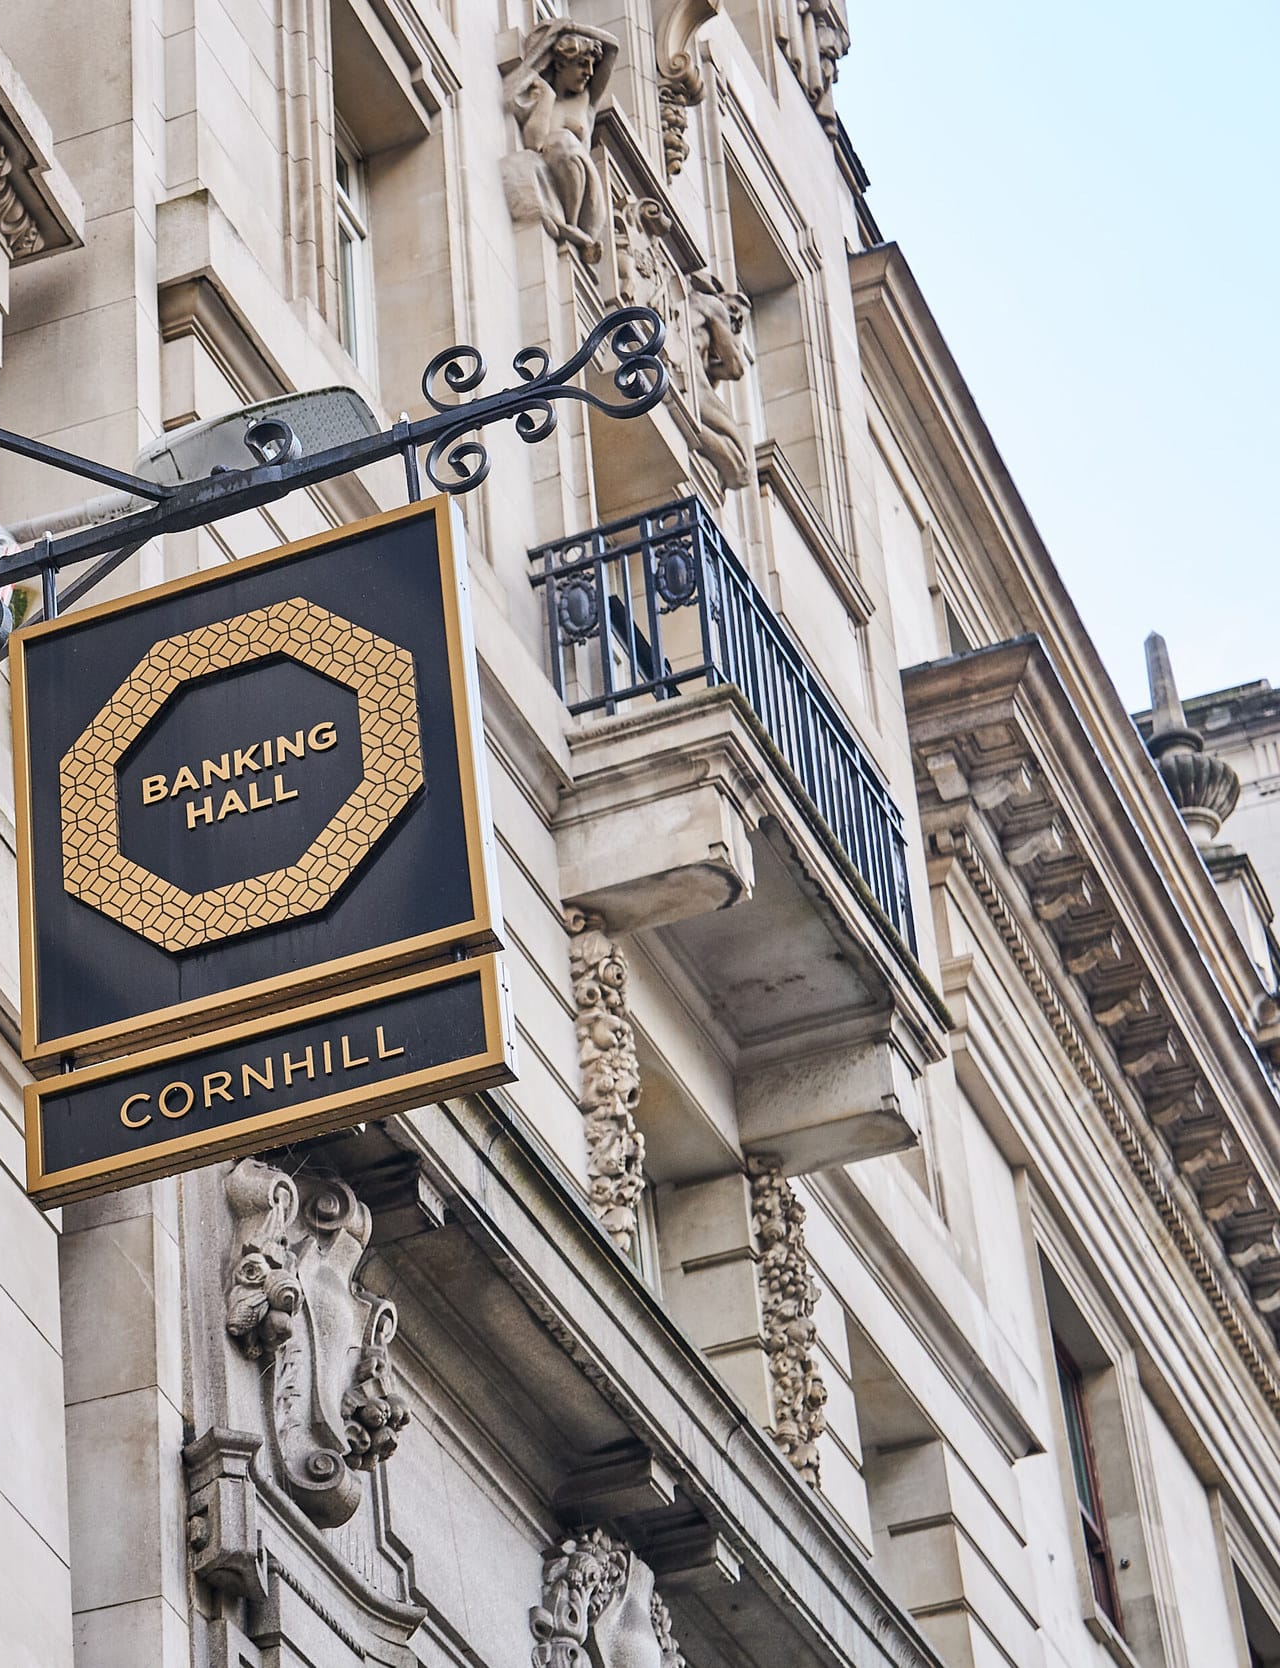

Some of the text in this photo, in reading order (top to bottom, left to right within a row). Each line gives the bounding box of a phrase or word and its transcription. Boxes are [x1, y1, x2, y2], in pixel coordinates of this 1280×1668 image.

[142, 721, 337, 805] BANKING
[186, 774, 298, 829] HALL
[120, 1025, 404, 1128] CORNHILL
